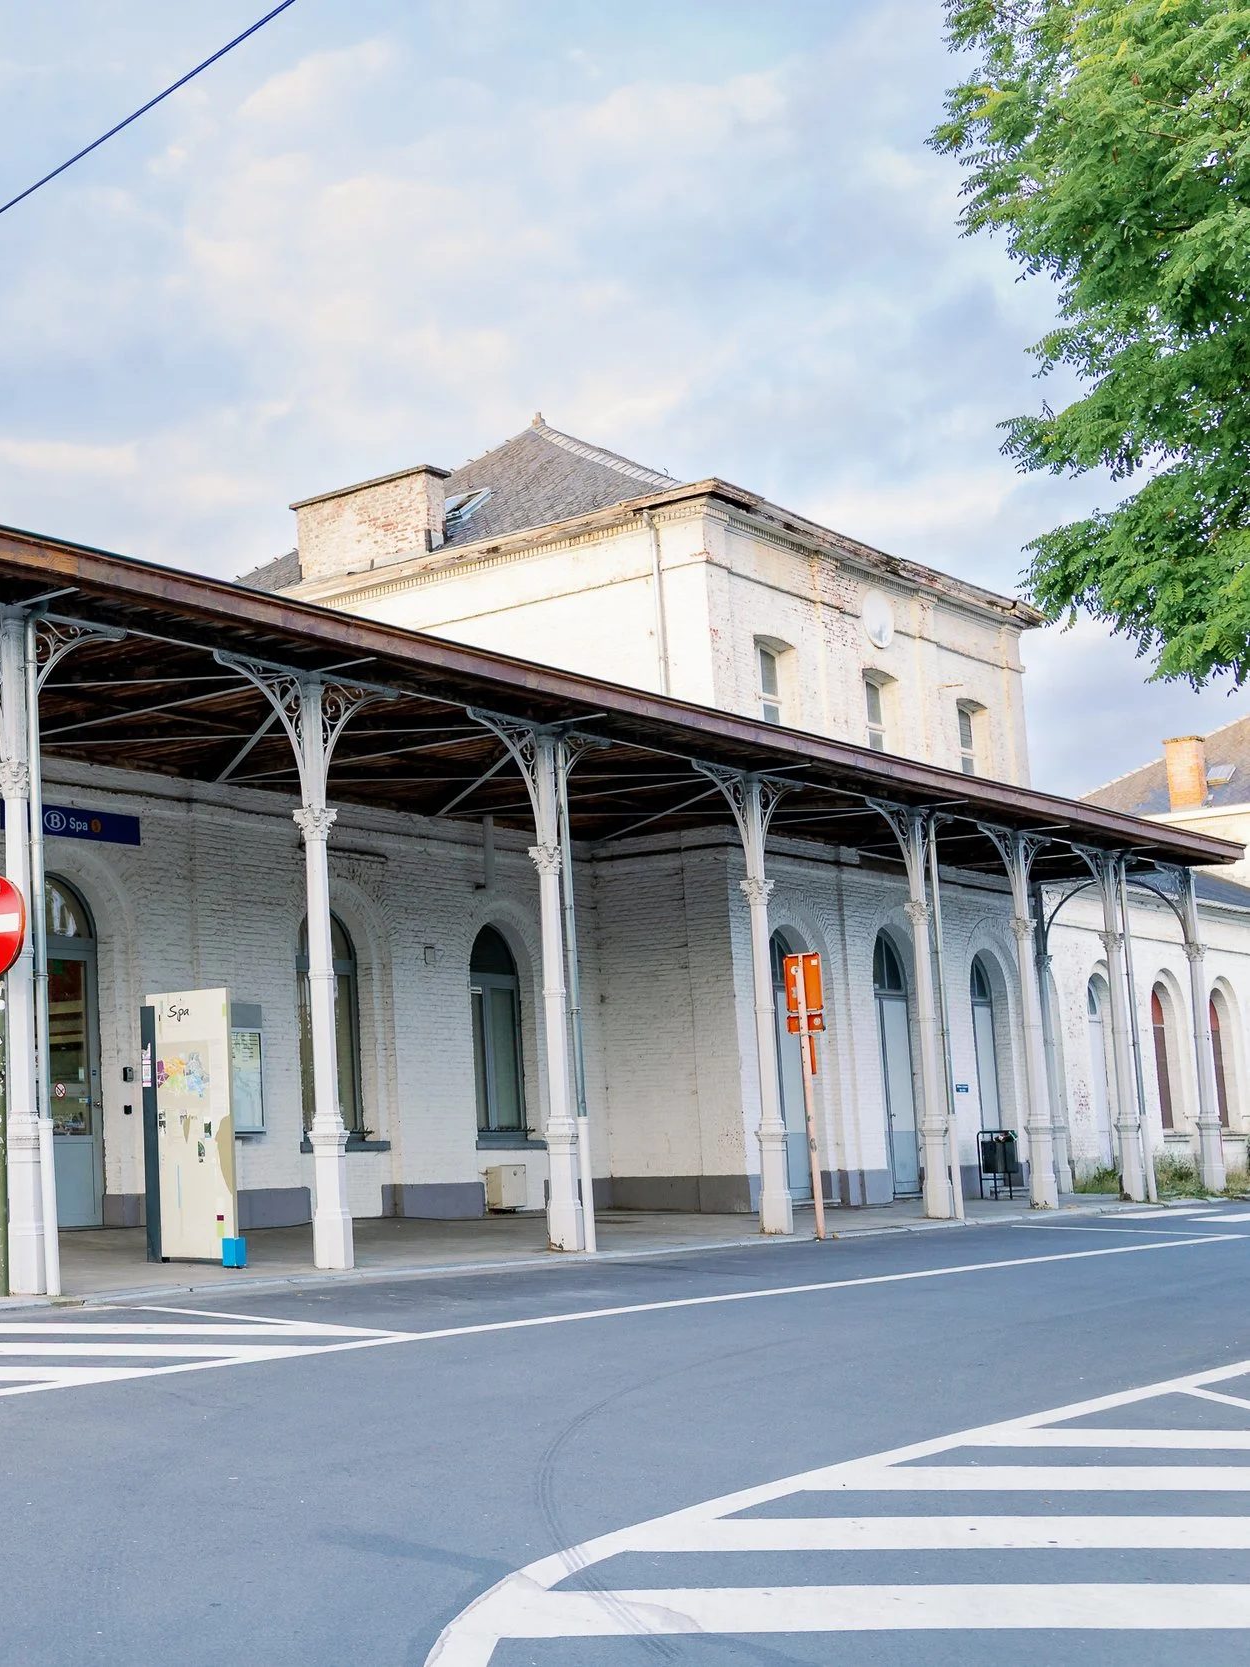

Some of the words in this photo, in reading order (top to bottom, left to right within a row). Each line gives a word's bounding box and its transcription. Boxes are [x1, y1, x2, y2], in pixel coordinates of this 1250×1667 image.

[50, 813, 62, 829] B
[69, 817, 88, 832] Spa
[167, 1005, 190, 1022] Spa
